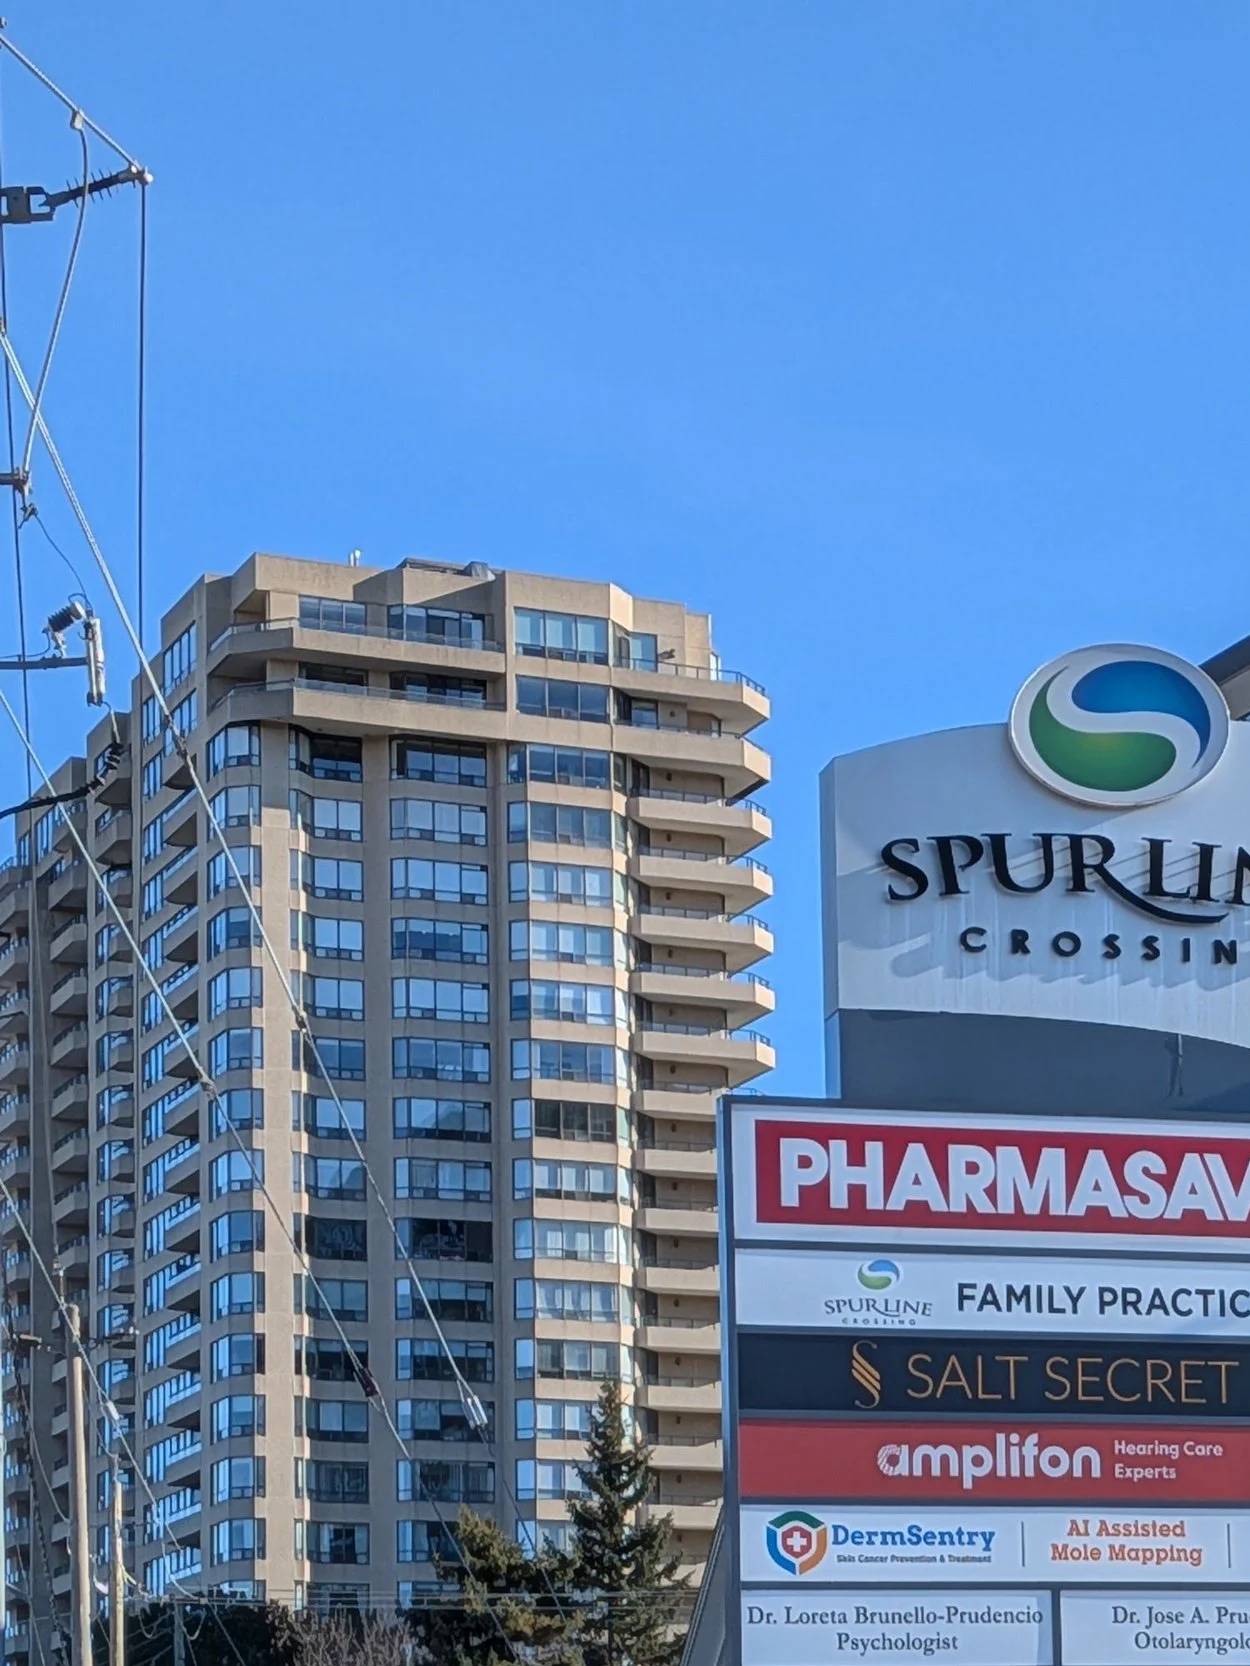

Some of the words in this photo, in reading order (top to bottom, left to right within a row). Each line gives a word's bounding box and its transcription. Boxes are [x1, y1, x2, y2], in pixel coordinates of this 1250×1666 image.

[824, 1297, 932, 1317] SPURLINE
[957, 1283, 1086, 1315] FAMILY
[907, 1353, 1029, 1400] SALT
[1045, 1357, 1239, 1404] SECRET
[877, 1432, 1101, 1489] amplifon
[1114, 1439, 1180, 1459] Hearing
[1183, 1442, 1224, 1457] Care
[1114, 1463, 1176, 1482] Experts
[831, 1524, 996, 1551] DermSentry
[1067, 1519, 1091, 1537] AI
[1096, 1519, 1186, 1538] Assisted
[836, 1554, 856, 1563] Skin
[858, 1554, 889, 1563] Cancer
[890, 1554, 938, 1563] Prevention
[939, 1554, 946, 1563] &
[947, 1554, 992, 1563] Treatment
[1050, 1543, 1102, 1562] Mole
[1108, 1543, 1203, 1567] Mapping
[746, 1606, 778, 1625] Dr.
[784, 1606, 848, 1625] Loreta
[854, 1605, 1044, 1625] Brunello-Prudencio
[1111, 1605, 1141, 1625] Dr.
[1144, 1605, 1185, 1629] Jose
[1189, 1606, 1210, 1625] A.
[836, 1632, 958, 1656] Psychologist
